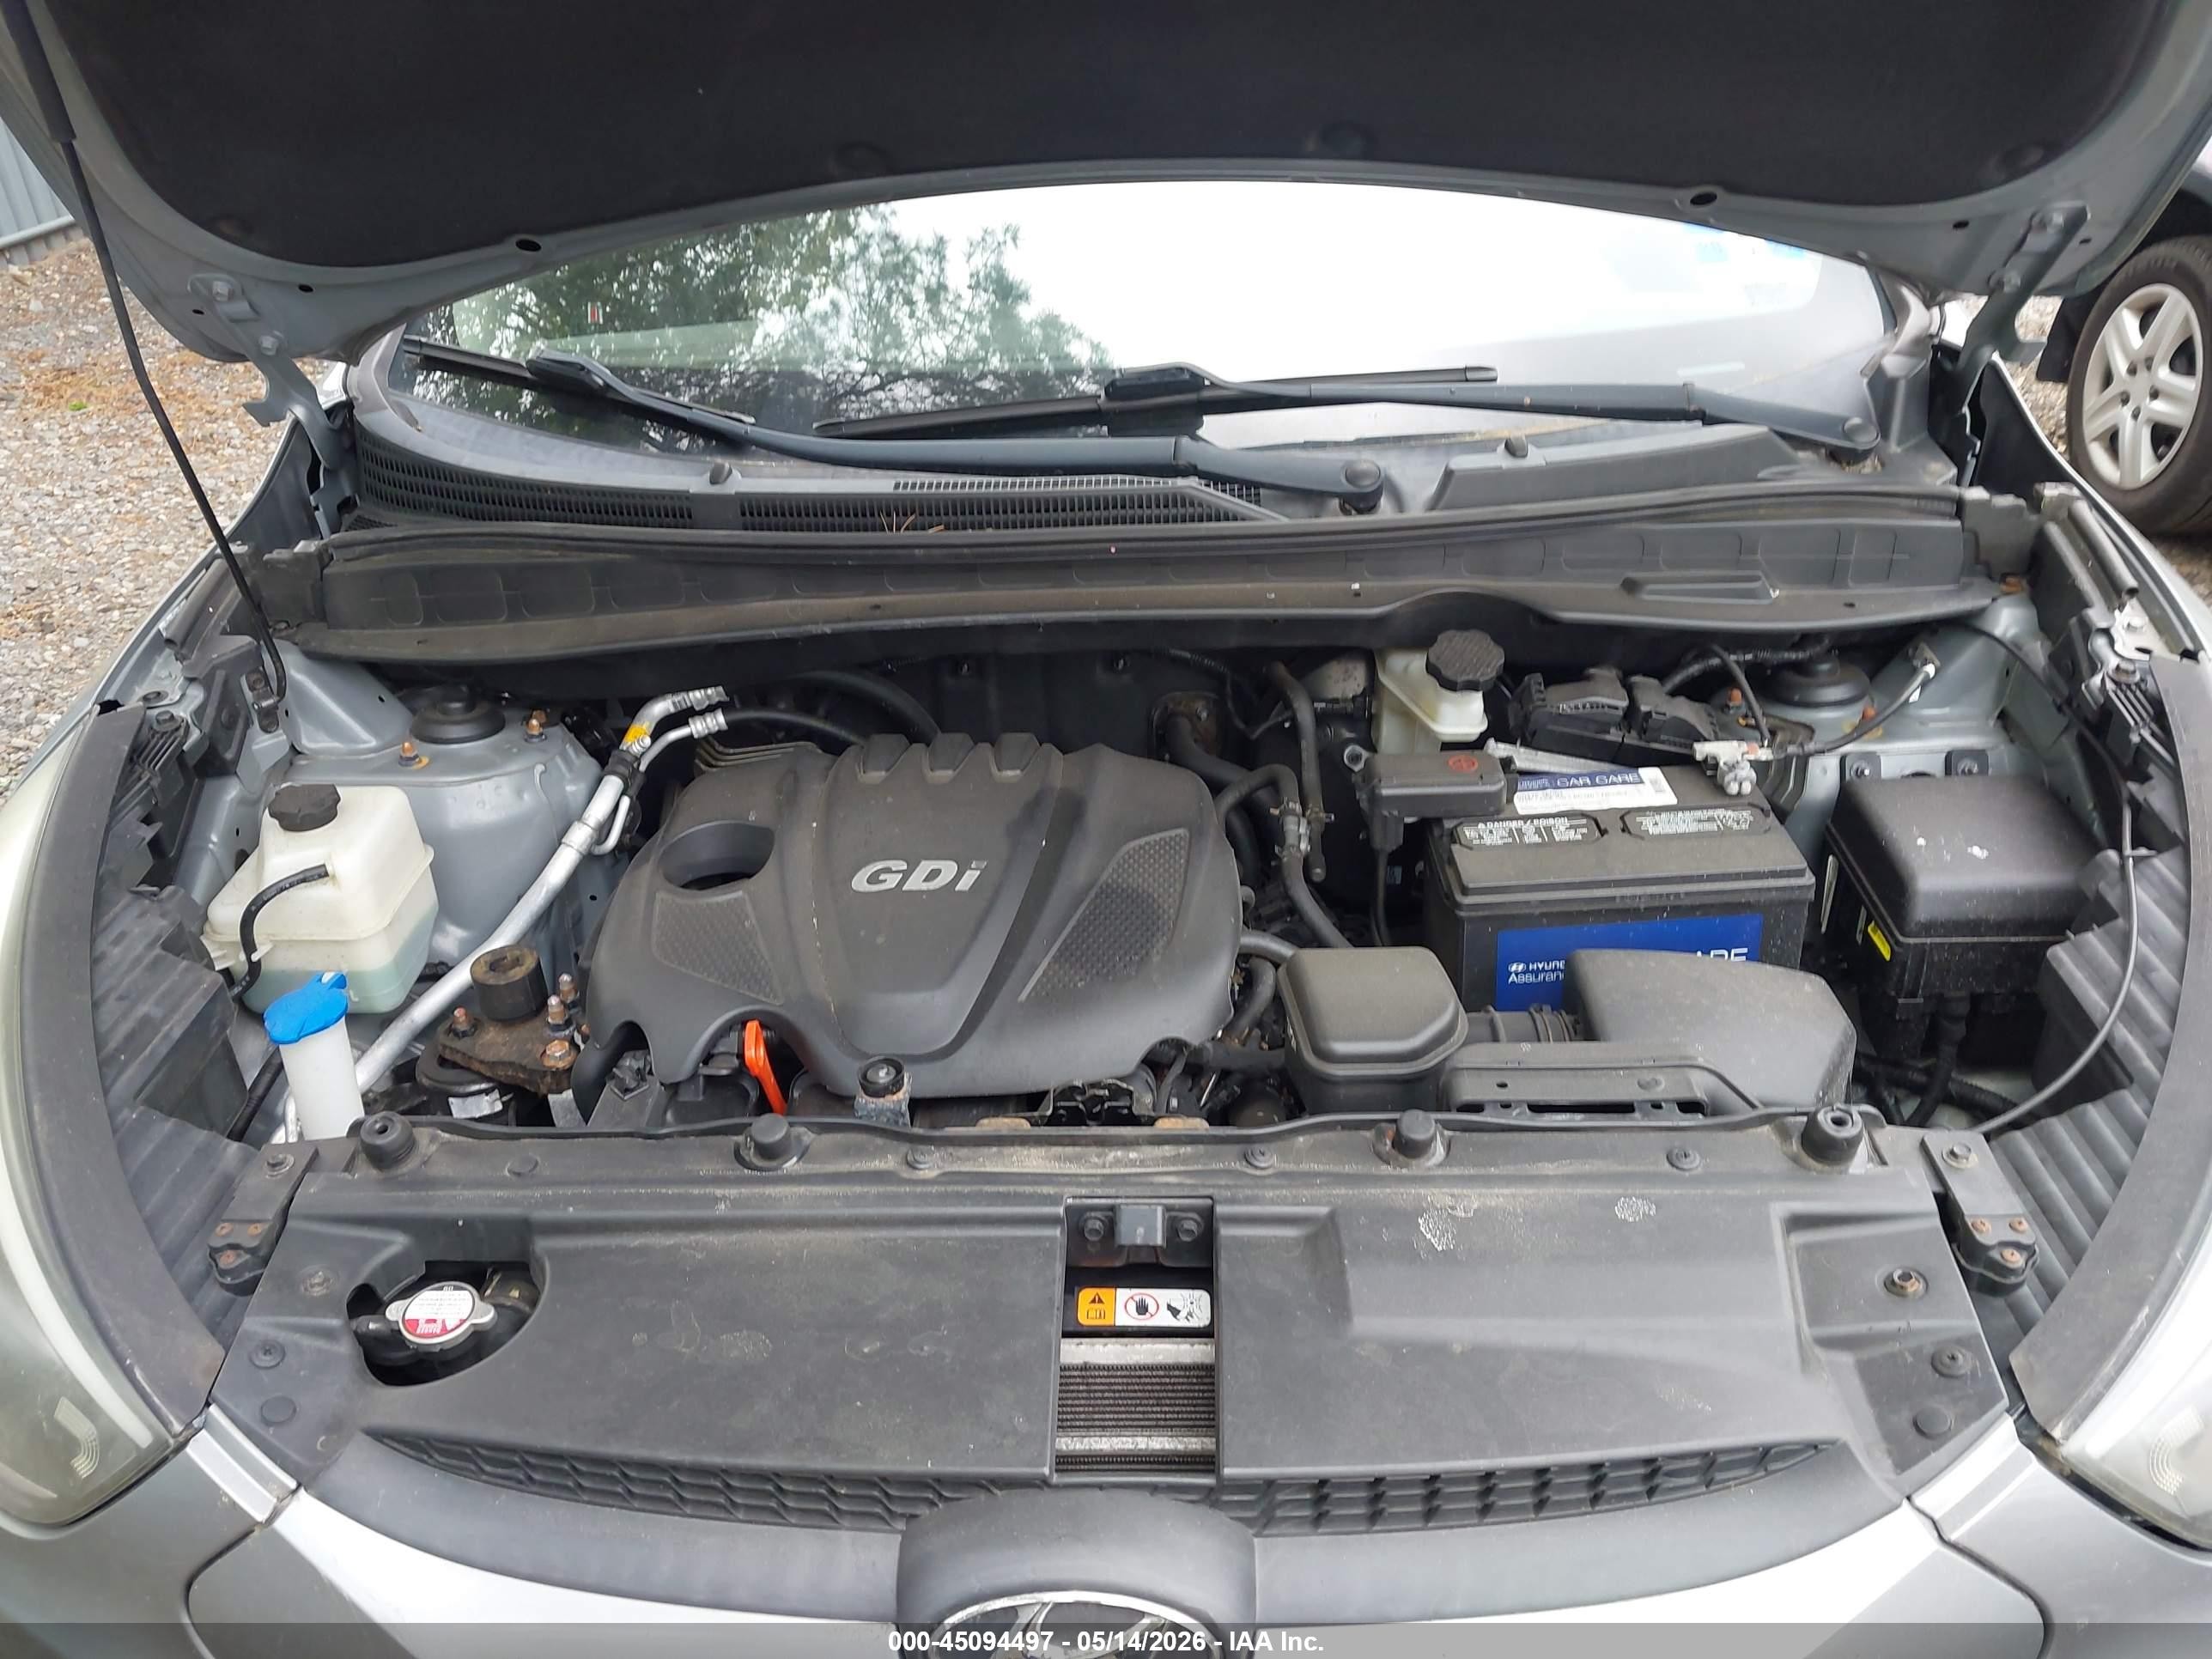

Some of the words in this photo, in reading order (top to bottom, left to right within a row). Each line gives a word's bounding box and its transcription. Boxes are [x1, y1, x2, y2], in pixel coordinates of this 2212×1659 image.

[1557, 775, 1591, 787] CAR
[1595, 772, 1641, 785] CARE
[851, 860, 988, 893] GDi
[1508, 970, 1565, 985] Assuran
